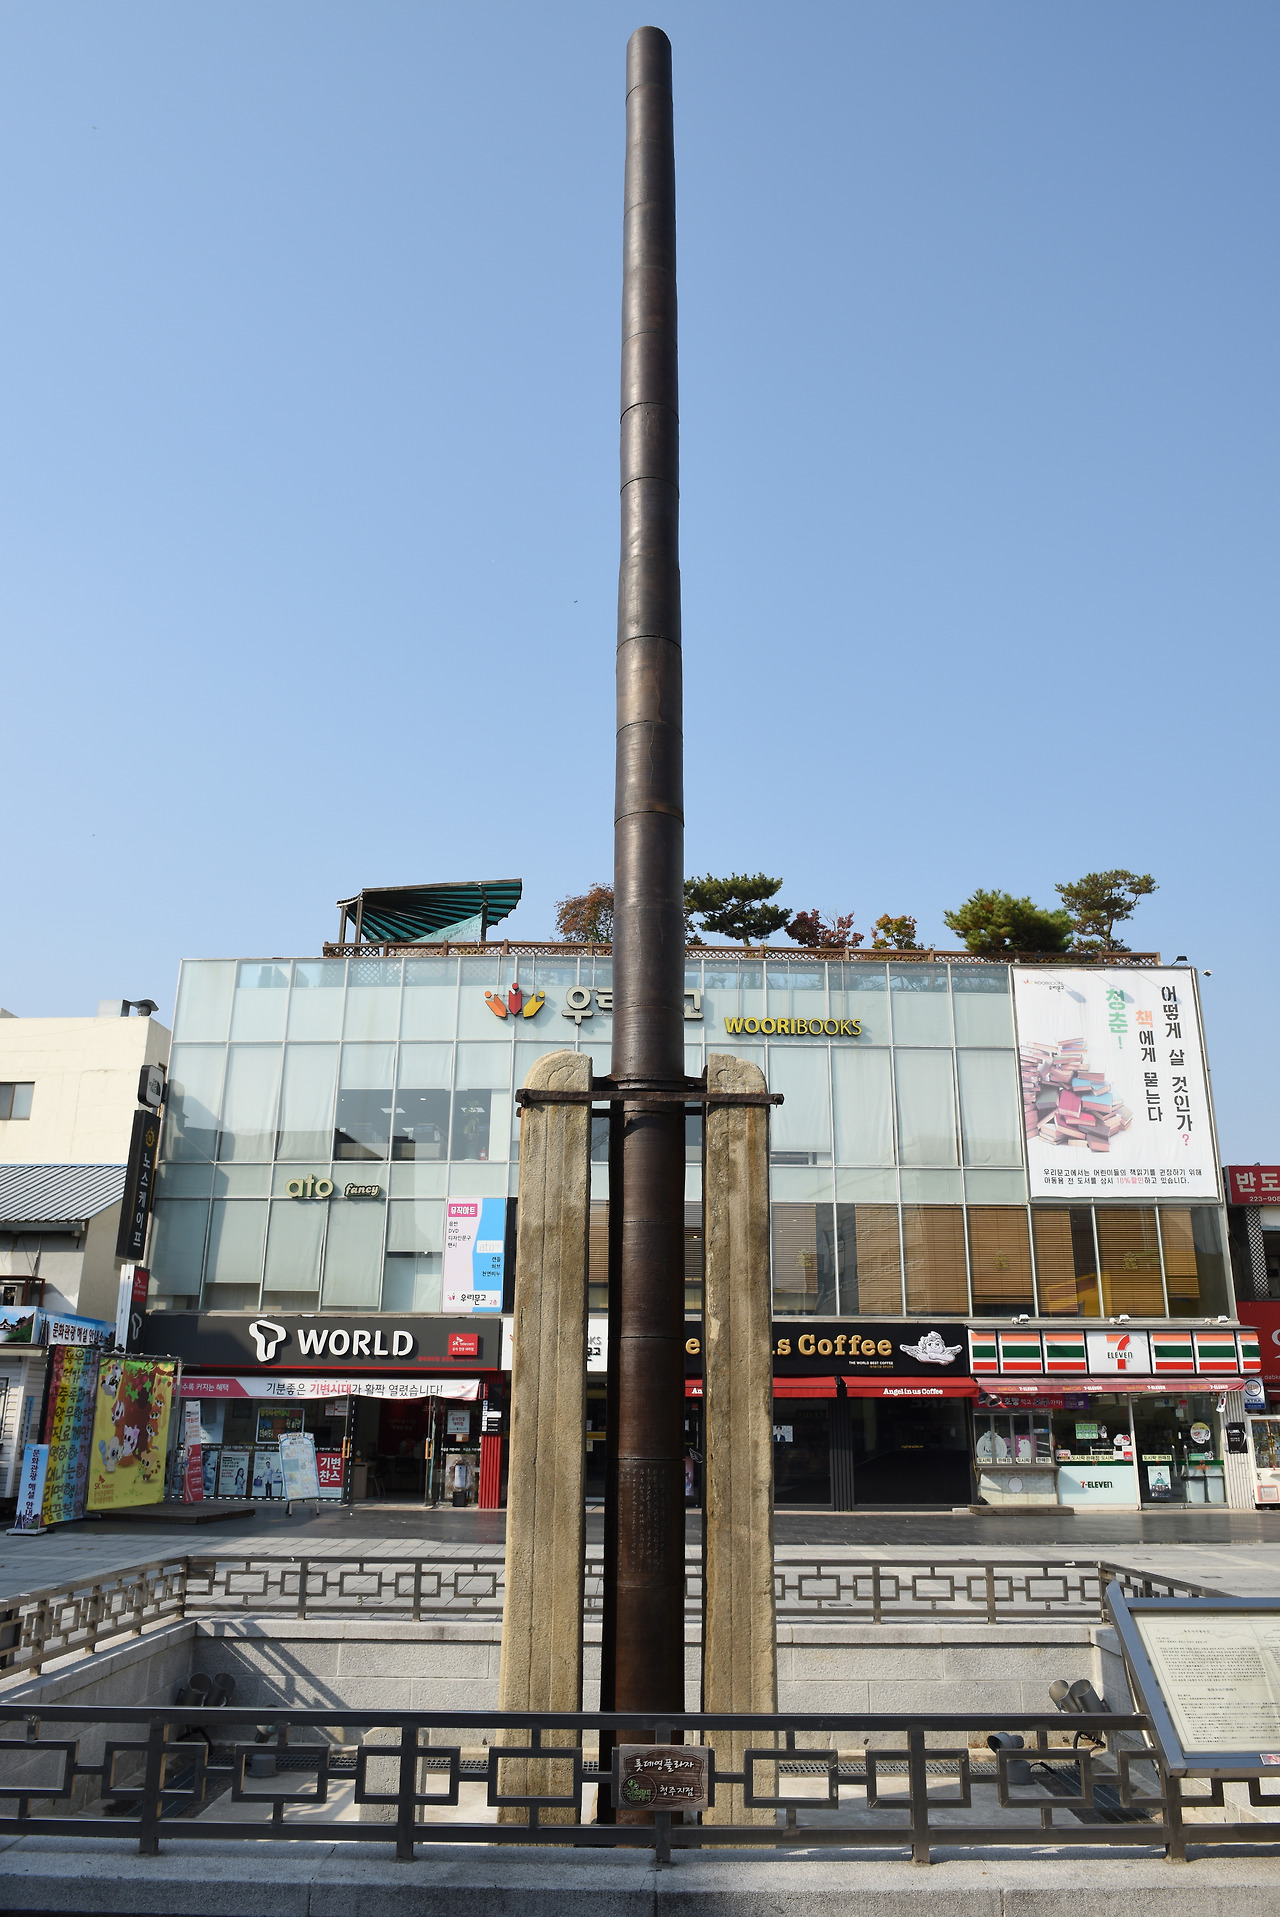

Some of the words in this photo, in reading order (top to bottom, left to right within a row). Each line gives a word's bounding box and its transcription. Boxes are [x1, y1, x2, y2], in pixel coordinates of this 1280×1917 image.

[1106, 988, 1128, 1049] 청춘!
[1161, 985, 1182, 1039] 어떻게
[724, 1017, 863, 1036] WOORIBOOKS
[1136, 1010, 1156, 1063] 책에게
[1169, 1050, 1185, 1066] 살
[1144, 1072, 1163, 1122] 묻는다
[1171, 1076, 1193, 1146] 것인가?
[1043, 1168, 1090, 1177] 우리문고에서는
[1093, 1168, 1127, 1177] 어린이들의
[1130, 1168, 1156, 1177] 책읽기를
[1159, 1168, 1186, 1177] 권장하기
[1188, 1168, 1202, 1177] 위해
[1044, 1177, 1064, 1185] 아동용
[1067, 1177, 1074, 1185] 전
[1077, 1177, 1096, 1185] 도서를
[1100, 1177, 1114, 1185] 상시
[1160, 1176, 1190, 1185] 있습니다.
[285, 1173, 334, 1198] ato
[344, 1182, 380, 1197] fancy
[1236, 1172, 1280, 1193] 반도
[132, 1152, 152, 1248] 노스케이프
[450, 1206, 476, 1215] 뮤직아트
[460, 1293, 486, 1306] 우리문고
[52, 1321, 76, 1341] 문화관광
[76, 1325, 88, 1343] 해설
[297, 1329, 414, 1356] WORLD
[798, 1334, 893, 1356] Coffee
[195, 1383, 214, 1392] 커지는
[216, 1383, 229, 1392] 혜택
[266, 1383, 306, 1396] 기분좋은
[309, 1382, 362, 1396] 기변시대가
[364, 1384, 385, 1396] 활짝
[388, 1383, 443, 1397] 열렸습니다!
[30, 1449, 40, 1480] 문화관광
[320, 1457, 341, 1469] 기변
[319, 1470, 341, 1483] 찬스
[27, 1482, 36, 1499] 해설
[634, 1758, 695, 1773] 롯데영플라자
[659, 1785, 695, 1797] 청주지점
